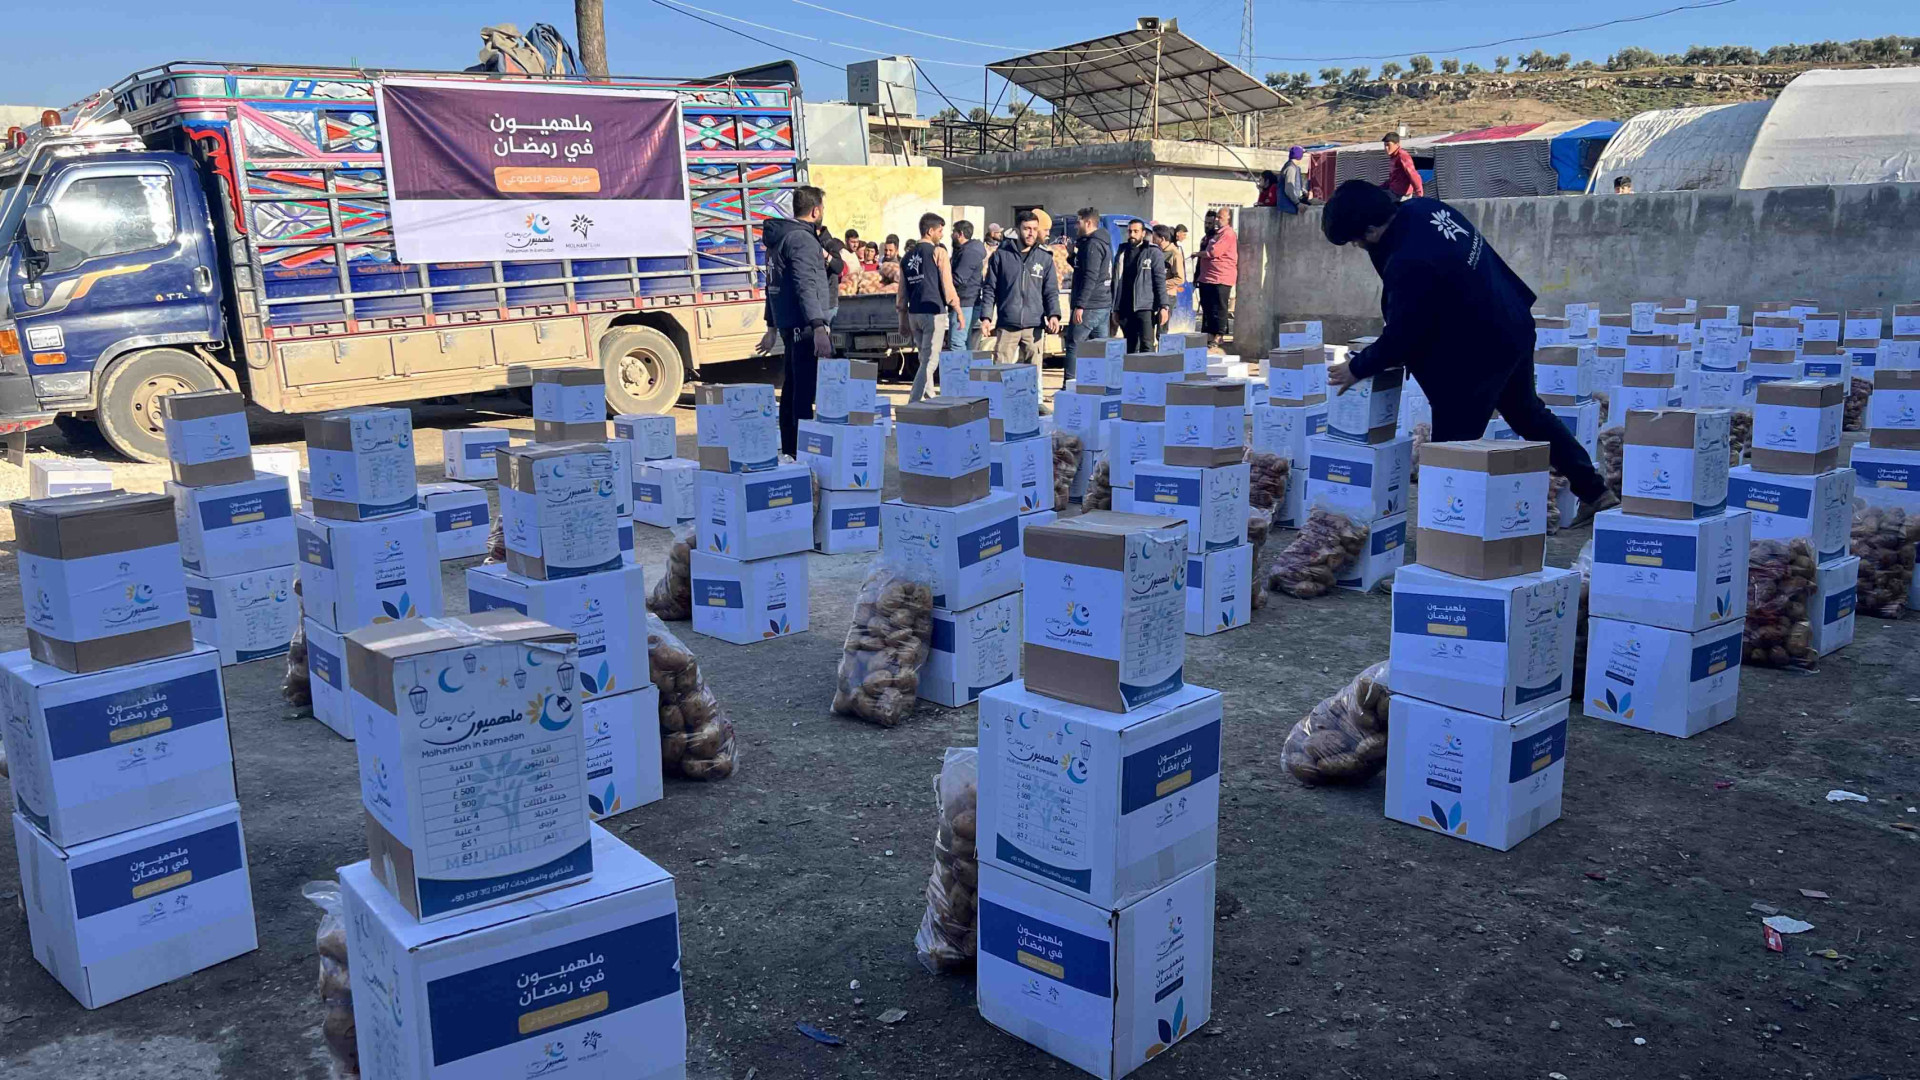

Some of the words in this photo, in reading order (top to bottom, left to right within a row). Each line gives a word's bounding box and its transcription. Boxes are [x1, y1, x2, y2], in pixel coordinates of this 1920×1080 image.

[490, 113, 592, 135] ملهميون
[494, 136, 557, 158] رمضان
[564, 139, 593, 162] في
[107, 693, 167, 714] ملهميون
[151, 703, 168, 717] في
[109, 711, 146, 725] رمضان
[423, 708, 523, 746] ملهميون
[469, 742, 480, 753] in
[483, 732, 525, 748] Ramadan
[1158, 742, 1192, 765] ملهميون
[1181, 755, 1191, 769] في
[449, 761, 473, 772] الكمية
[1158, 762, 1179, 777] رمضان
[460, 786, 476, 796] 500
[534, 784, 554, 793] حلاوة
[462, 800, 477, 809] 900
[130, 848, 188, 871] ملهميون
[172, 857, 189, 872] في
[132, 866, 168, 882] رمضان
[1017, 924, 1062, 947] ملهميون
[1018, 936, 1045, 954] رمضان
[1048, 951, 1062, 959] في
[517, 952, 604, 988] ملهميون
[580, 969, 605, 991] في
[519, 981, 572, 1006] رمضان
